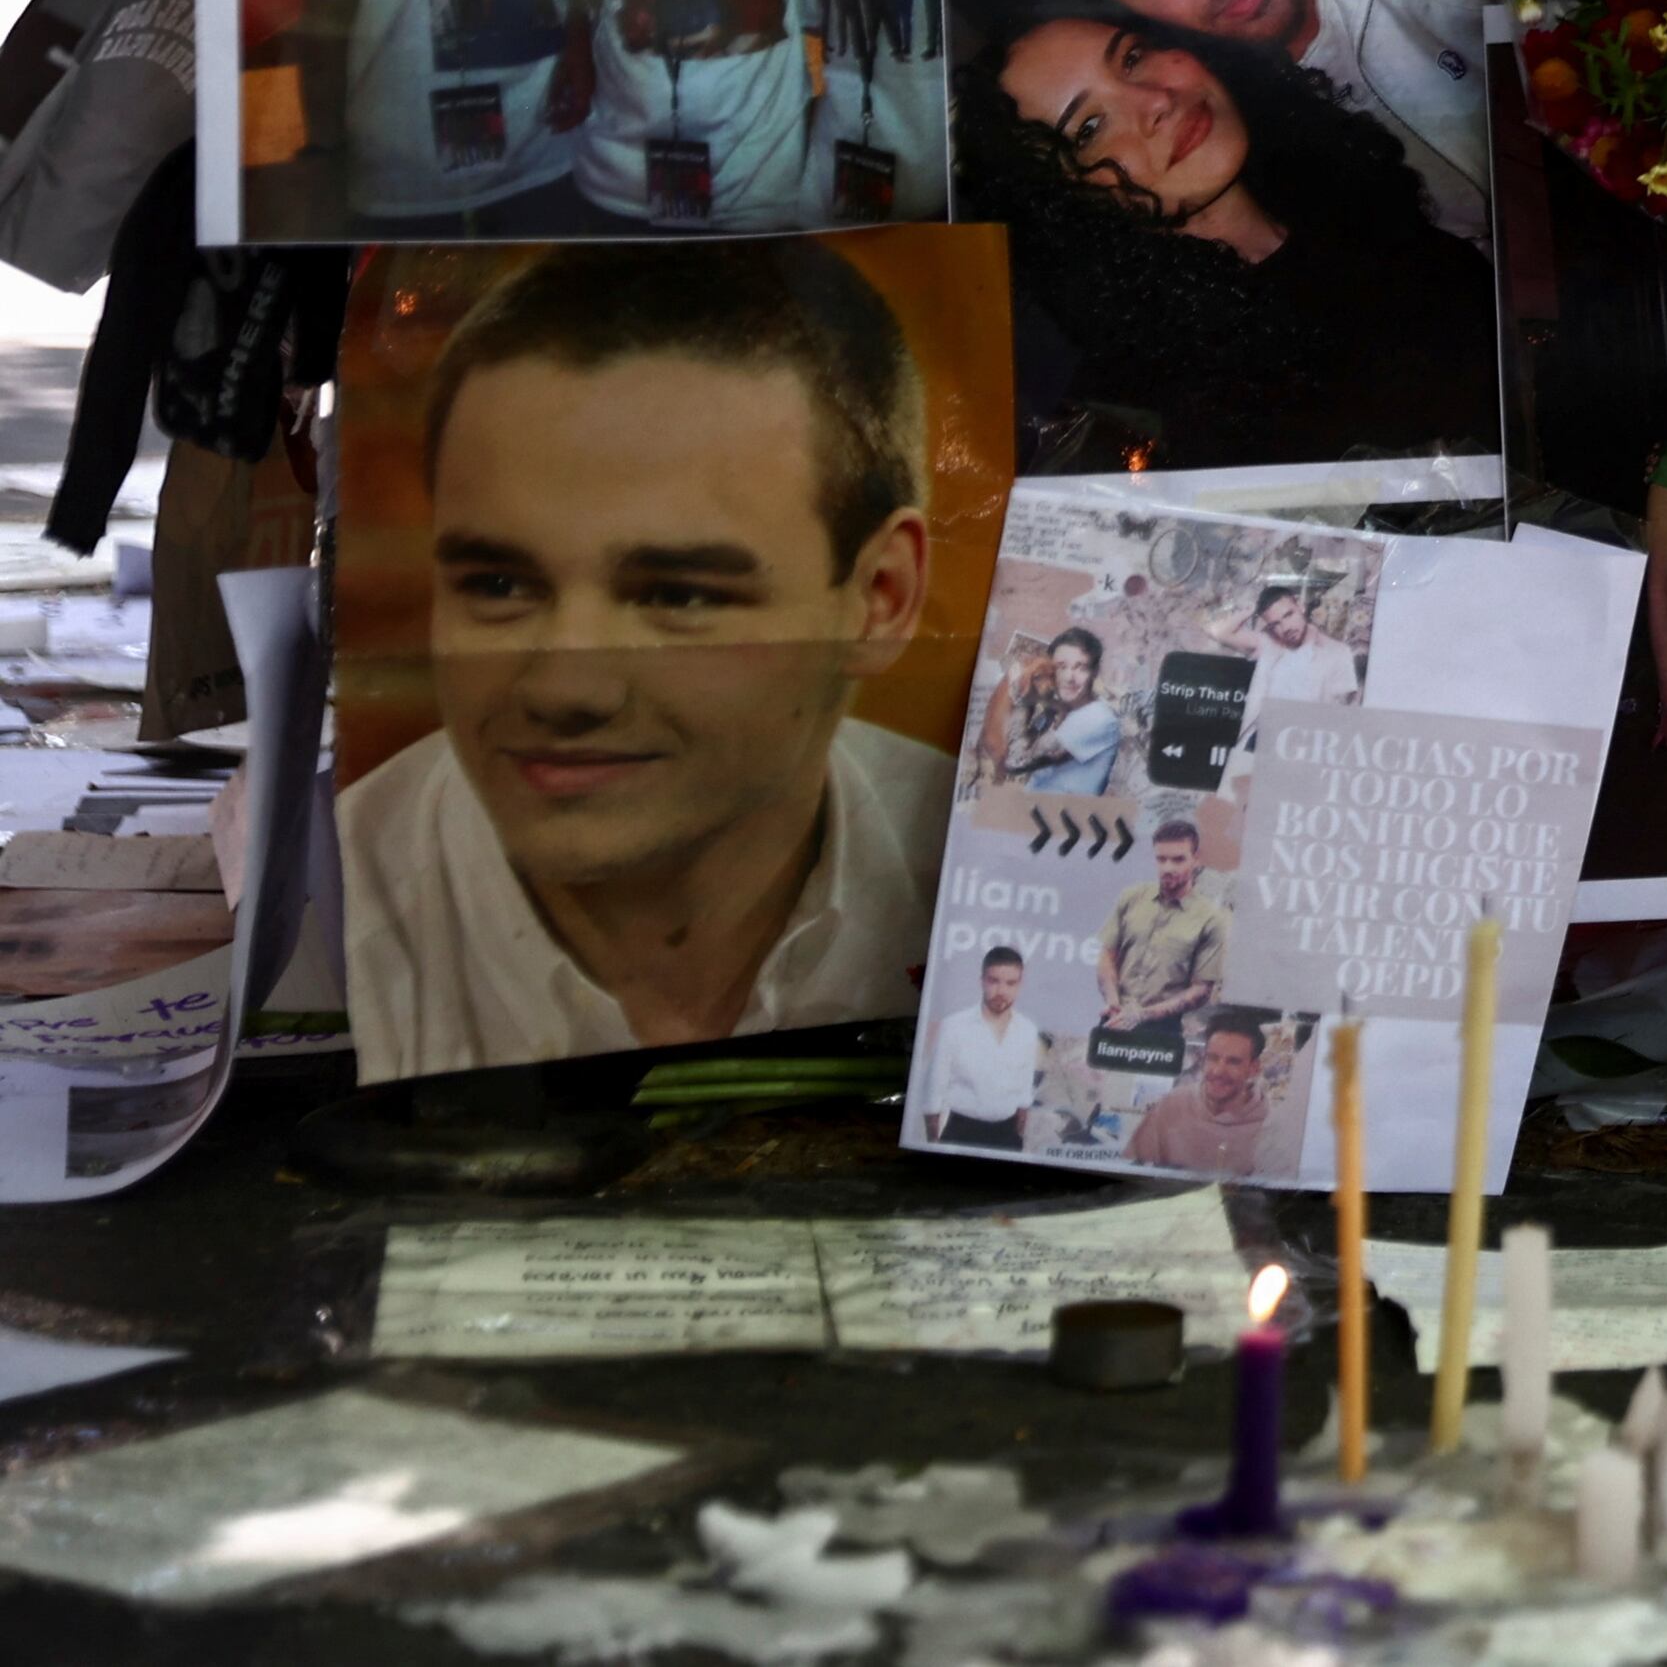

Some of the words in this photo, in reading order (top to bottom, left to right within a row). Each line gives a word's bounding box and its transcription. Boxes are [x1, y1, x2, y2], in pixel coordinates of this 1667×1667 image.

[1160, 682, 1195, 699] Strip
[1199, 687, 1230, 701] That
[1186, 704, 1217, 716] Liam
[1276, 726, 1475, 778] GRACIAS
[1487, 746, 1580, 786] POR
[1319, 769, 1456, 813] TODO
[1467, 783, 1528, 818] LO
[1276, 801, 1456, 850] BONITO
[1469, 820, 1560, 859] QUE
[1269, 839, 1361, 881] NOS
[1377, 849, 1558, 895] HICISTE
[952, 866, 1059, 916] liam
[1256, 875, 1380, 920] VIVIR
[1393, 889, 1485, 928] CON
[1503, 897, 1561, 932] TU
[944, 923, 1103, 966] payne
[1291, 916, 1503, 963] TALENT
[1336, 958, 1463, 1002] QEPD
[138, 991, 219, 1021] te
[1097, 1042, 1174, 1064] liampayne
